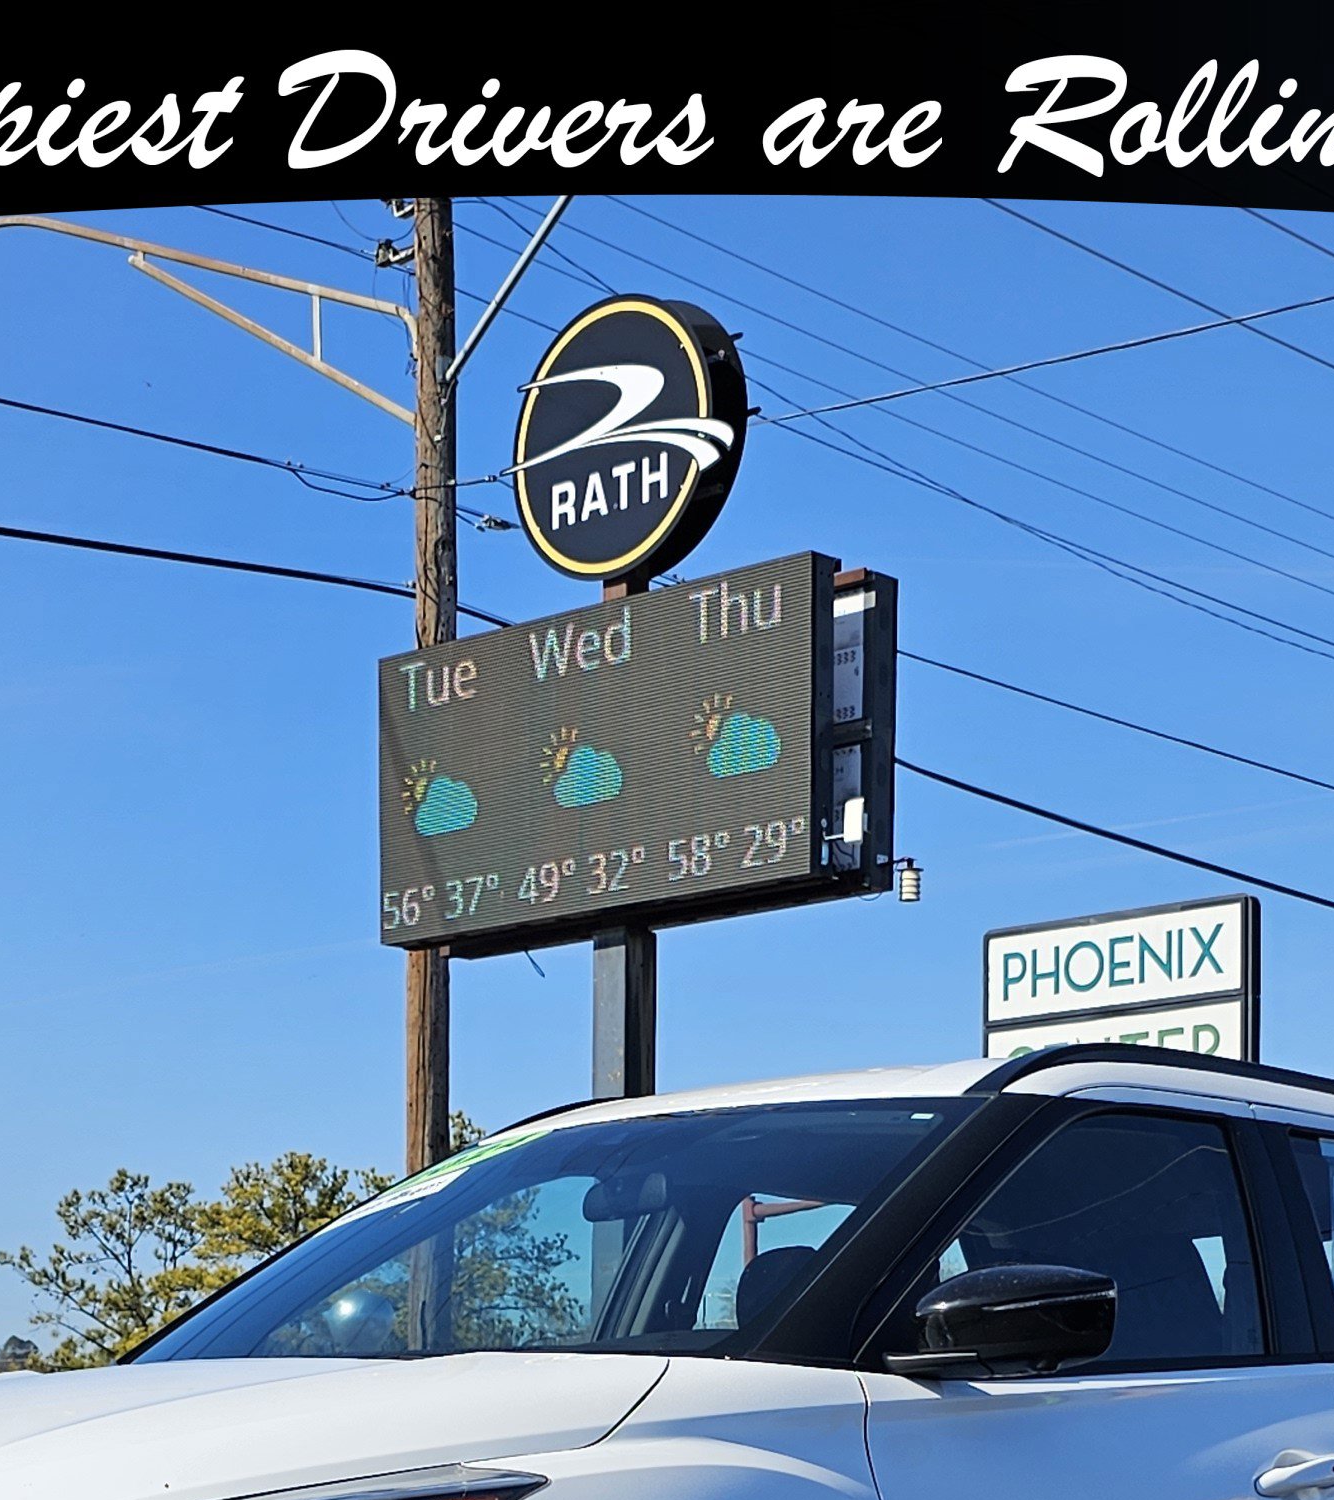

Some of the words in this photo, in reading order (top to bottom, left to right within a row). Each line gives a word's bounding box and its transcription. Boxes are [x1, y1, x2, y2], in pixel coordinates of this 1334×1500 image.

[551, 450, 670, 531] RATH
[398, 659, 478, 713] Tue
[528, 605, 632, 682] Wed
[688, 580, 783, 645] Thu
[1002, 922, 1225, 1002] PHOENIX
